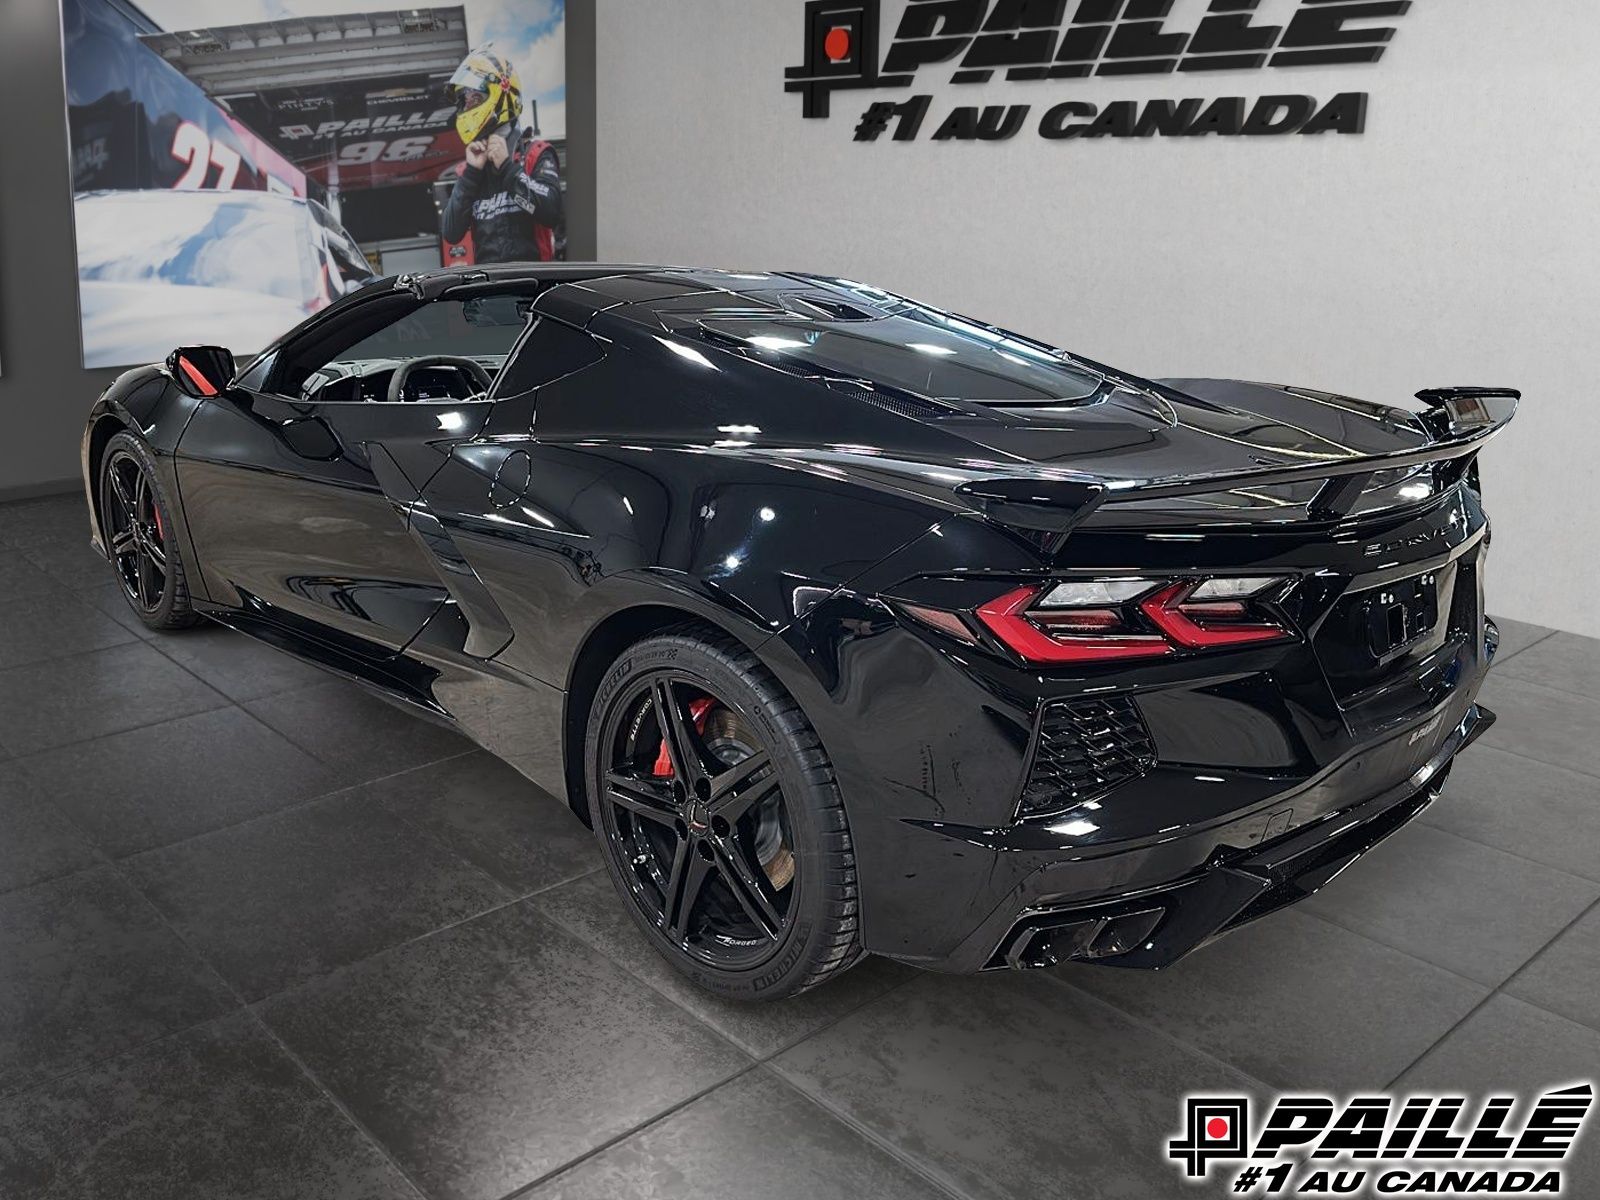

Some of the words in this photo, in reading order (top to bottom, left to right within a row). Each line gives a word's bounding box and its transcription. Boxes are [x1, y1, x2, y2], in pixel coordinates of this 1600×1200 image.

[366, 94, 430, 106] CHEVROLET
[853, 95, 934, 141] #1
[931, 105, 1031, 141] AU
[1038, 92, 1369, 140] CANADA
[340, 129, 366, 138] AU
[371, 120, 448, 134] CANADA
[171, 120, 241, 190] 27
[336, 135, 435, 166] 96
[630, 698, 653, 741] CORVETTE
